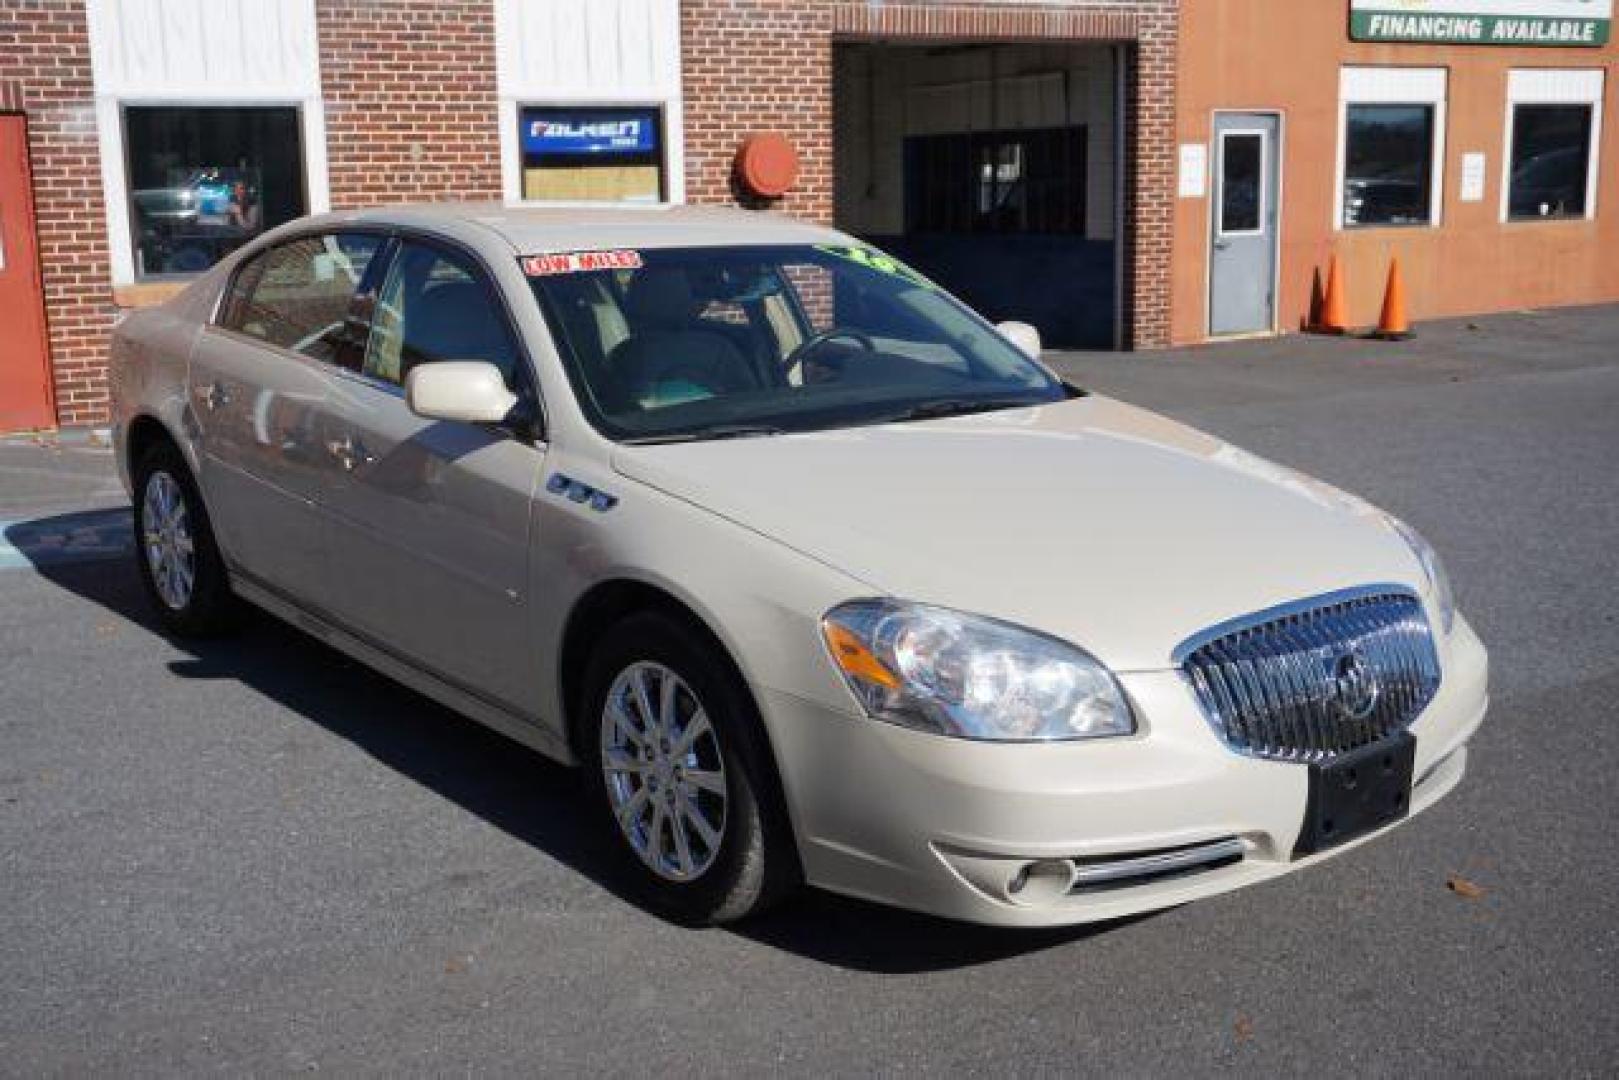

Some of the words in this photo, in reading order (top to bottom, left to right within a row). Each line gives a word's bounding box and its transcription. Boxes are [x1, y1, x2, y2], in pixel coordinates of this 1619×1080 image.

[1368, 15, 1481, 39] FINANCING
[1491, 19, 1596, 41] AVAILABLE
[525, 254, 571, 273] LOW
